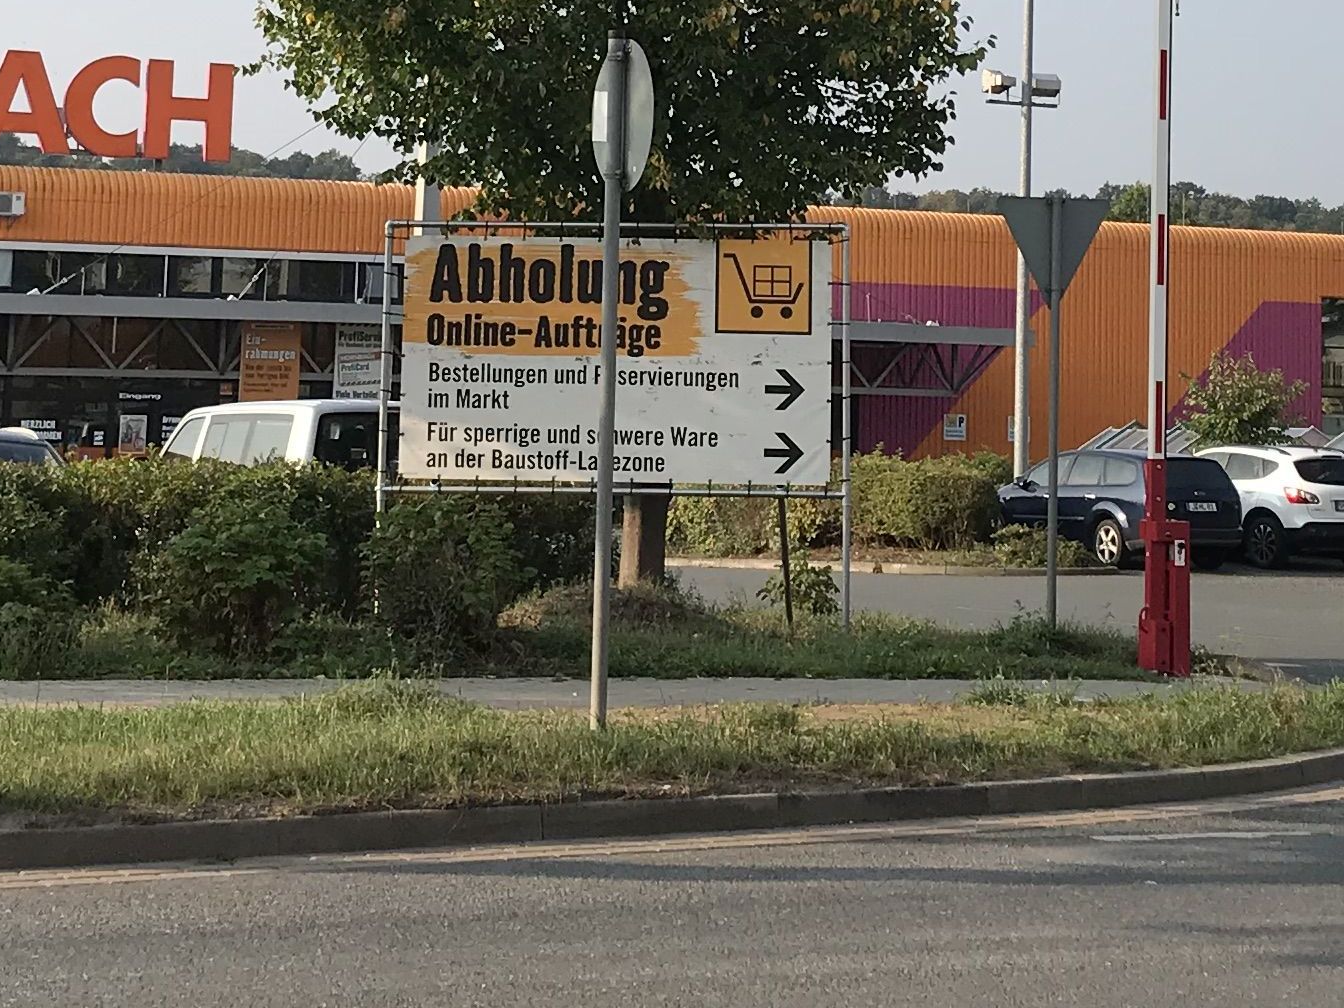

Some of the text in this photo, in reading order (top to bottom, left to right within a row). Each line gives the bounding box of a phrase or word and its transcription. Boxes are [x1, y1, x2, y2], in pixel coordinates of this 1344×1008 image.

[429, 242, 670, 321] Abholung
[427, 313, 662, 357] Online-Auftäge
[428, 362, 740, 390] Bestellungen und Rservierungen
[118, 392, 162, 400] Eingang
[428, 388, 510, 410] im Markt
[427, 422, 719, 448] Für sperrige und swere Ware
[427, 449, 666, 473] an der Baustoff-Laezone
